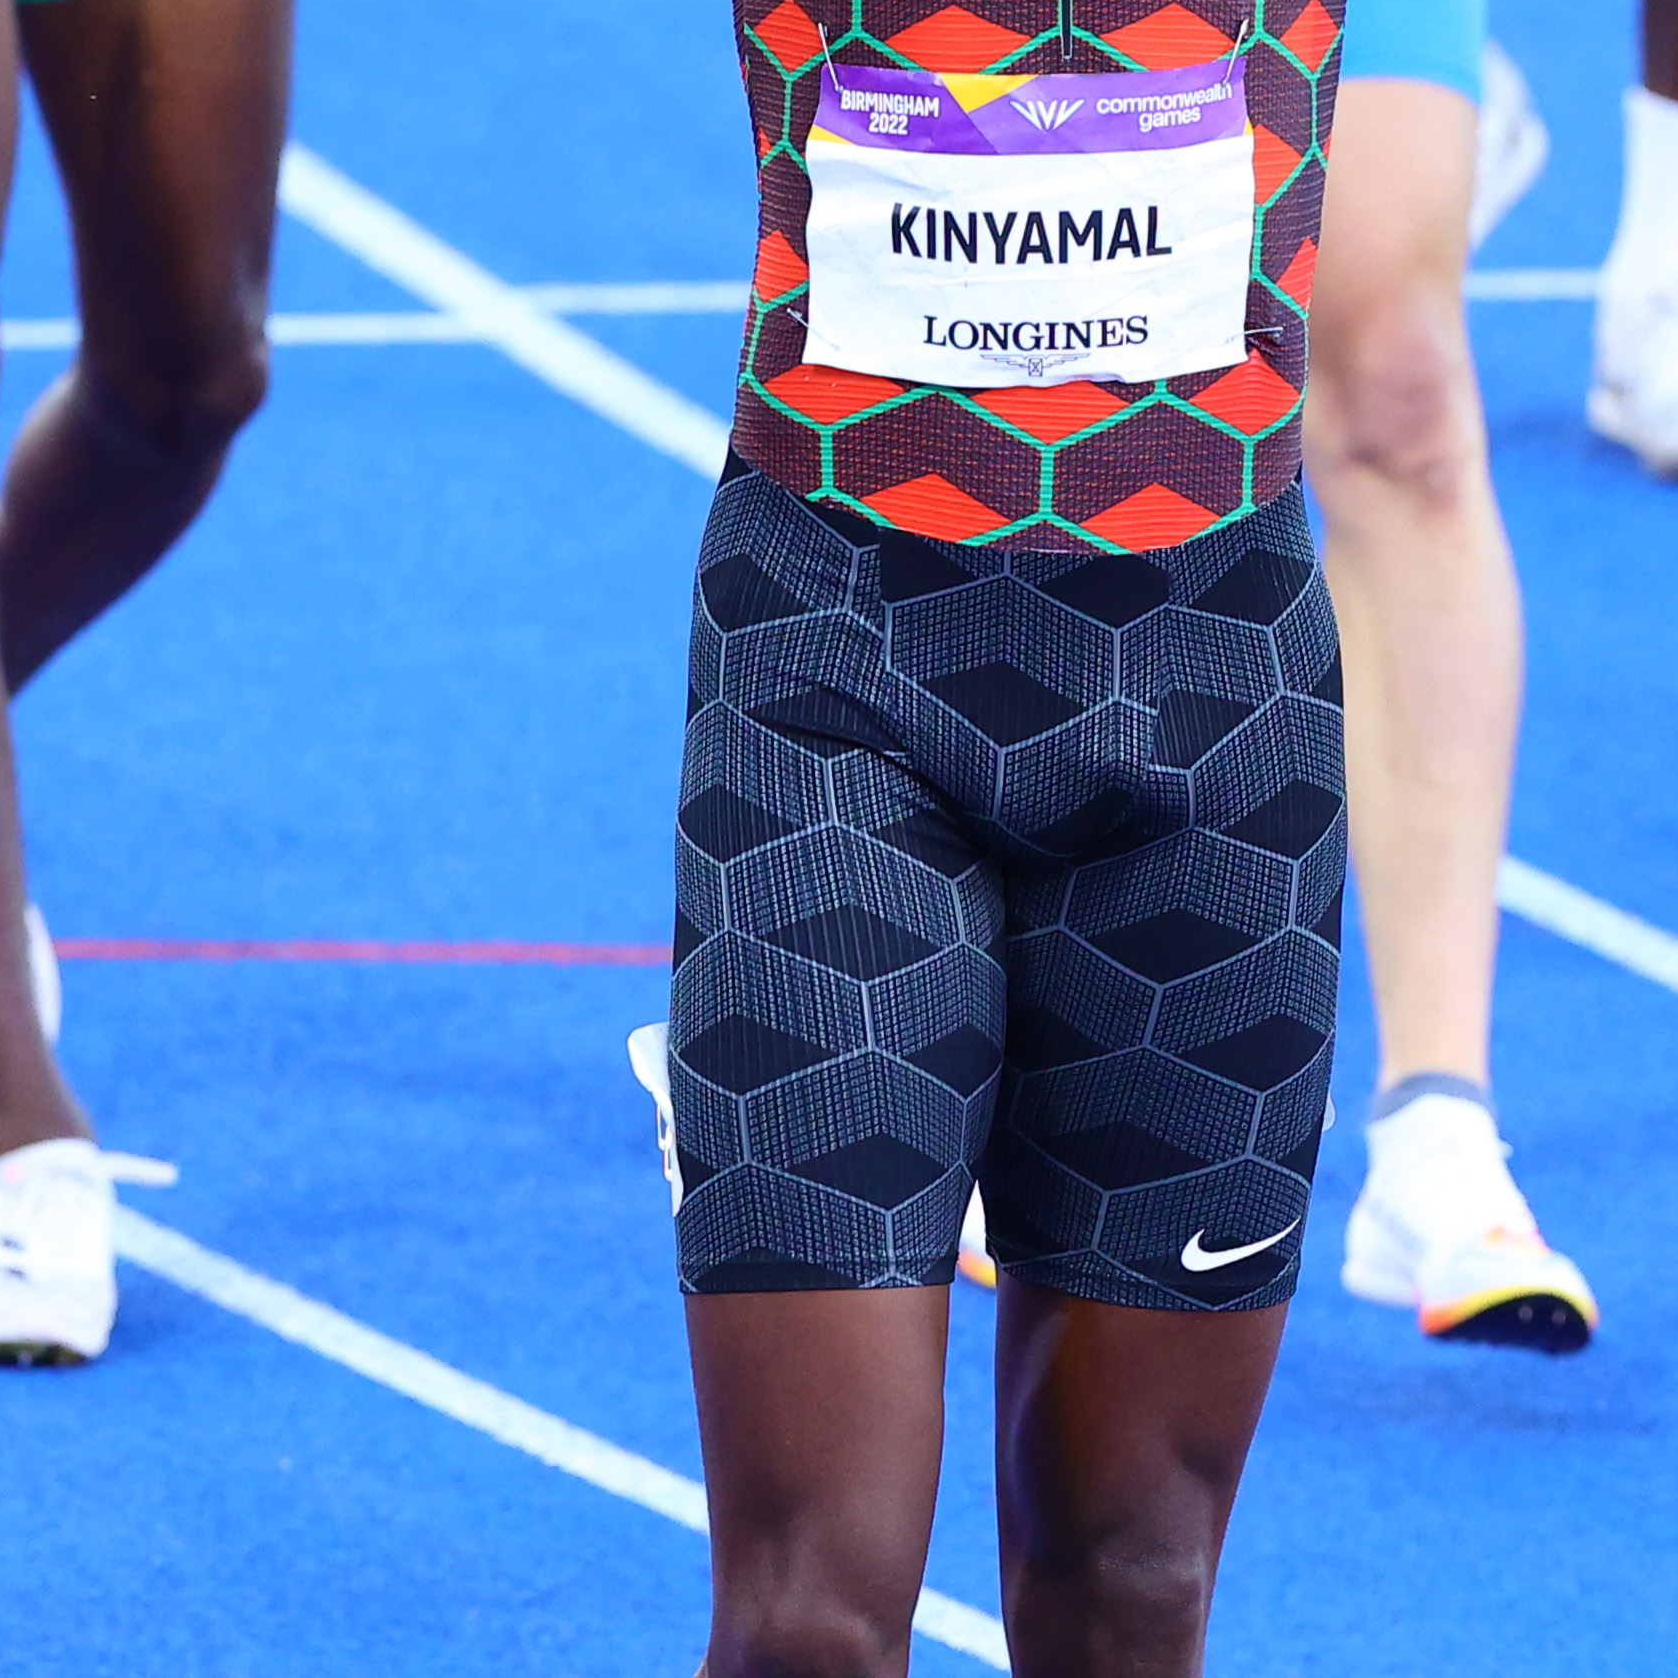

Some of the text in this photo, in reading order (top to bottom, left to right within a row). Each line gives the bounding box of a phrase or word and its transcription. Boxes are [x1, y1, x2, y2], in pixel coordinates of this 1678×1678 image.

[840, 89, 940, 118] BIRMINGHAM
[1096, 82, 1233, 114] commonwealth
[868, 112, 908, 136] 2022
[1138, 107, 1201, 132] games
[890, 202, 1172, 265] KINYAMAL
[923, 314, 1149, 352] LONGINES
